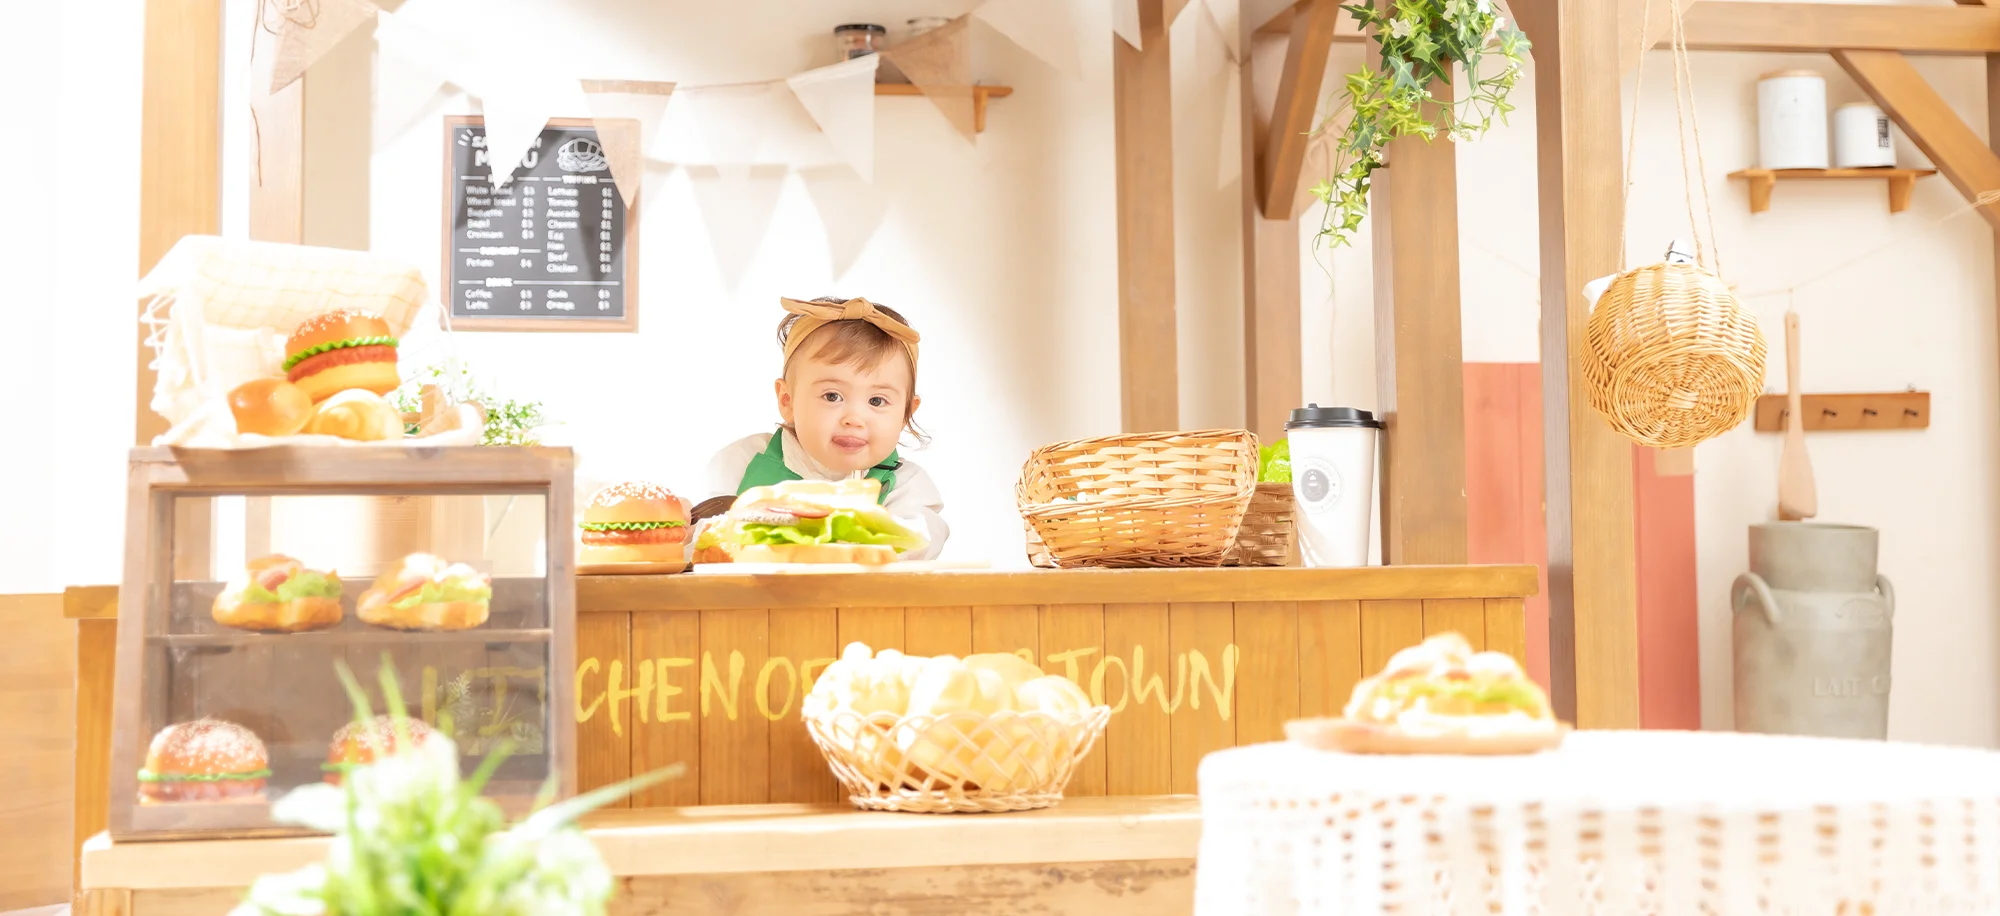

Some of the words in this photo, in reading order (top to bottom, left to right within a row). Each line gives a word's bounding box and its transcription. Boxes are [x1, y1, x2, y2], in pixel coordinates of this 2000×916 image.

[474, 149, 539, 169] MU
[466, 186, 488, 194] White
[548, 186, 578, 196] Lettuce
[466, 197, 491, 205] Wheat
[494, 197, 517, 207] bread
[547, 198, 578, 207] Tomato
[546, 209, 579, 218] Avocado
[547, 220, 577, 229] Cheese
[467, 230, 504, 238] Croissant
[548, 230, 564, 241] Egg
[548, 252, 568, 262] Beef
[466, 258, 494, 267] Potato
[547, 264, 578, 272] Chicken
[465, 289, 493, 298] Coffee
[547, 290, 568, 298] Soda
[466, 301, 489, 309] Latte
[546, 301, 574, 310] Orange
[1047, 643, 1240, 721] TOWN
[1812, 677, 1861, 698] LAIT
